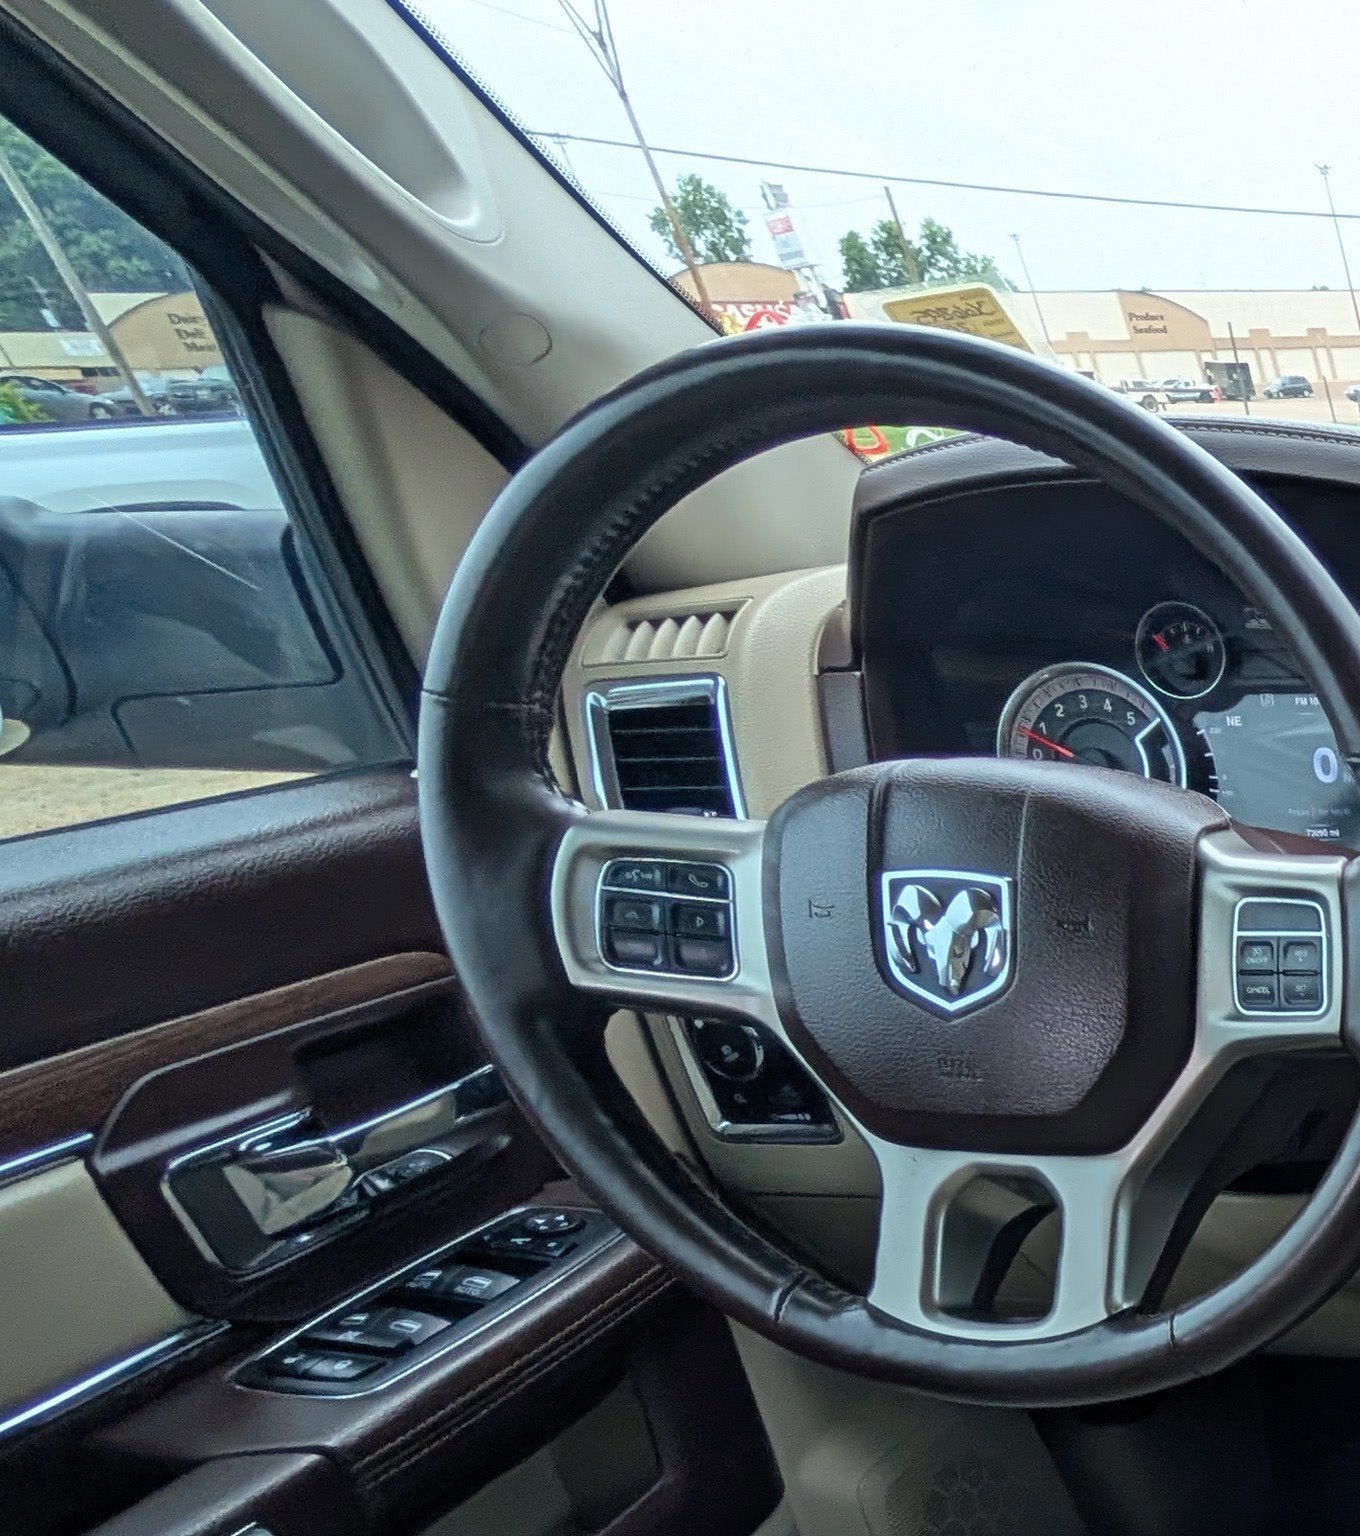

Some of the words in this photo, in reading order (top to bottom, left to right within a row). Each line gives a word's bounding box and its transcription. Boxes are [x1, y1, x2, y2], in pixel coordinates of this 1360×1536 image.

[1128, 312, 1165, 321] Produce
[1132, 325, 1168, 334] Seafood
[1078, 695, 1088, 709] 3
[1103, 698, 1113, 712] 4
[1054, 703, 1065, 717] 2
[1126, 711, 1136, 726] 5
[1226, 715, 1242, 726] NE
[1039, 721, 1047, 734] 1
[1032, 748, 1044, 760] 0
[1313, 747, 1338, 783] 0
